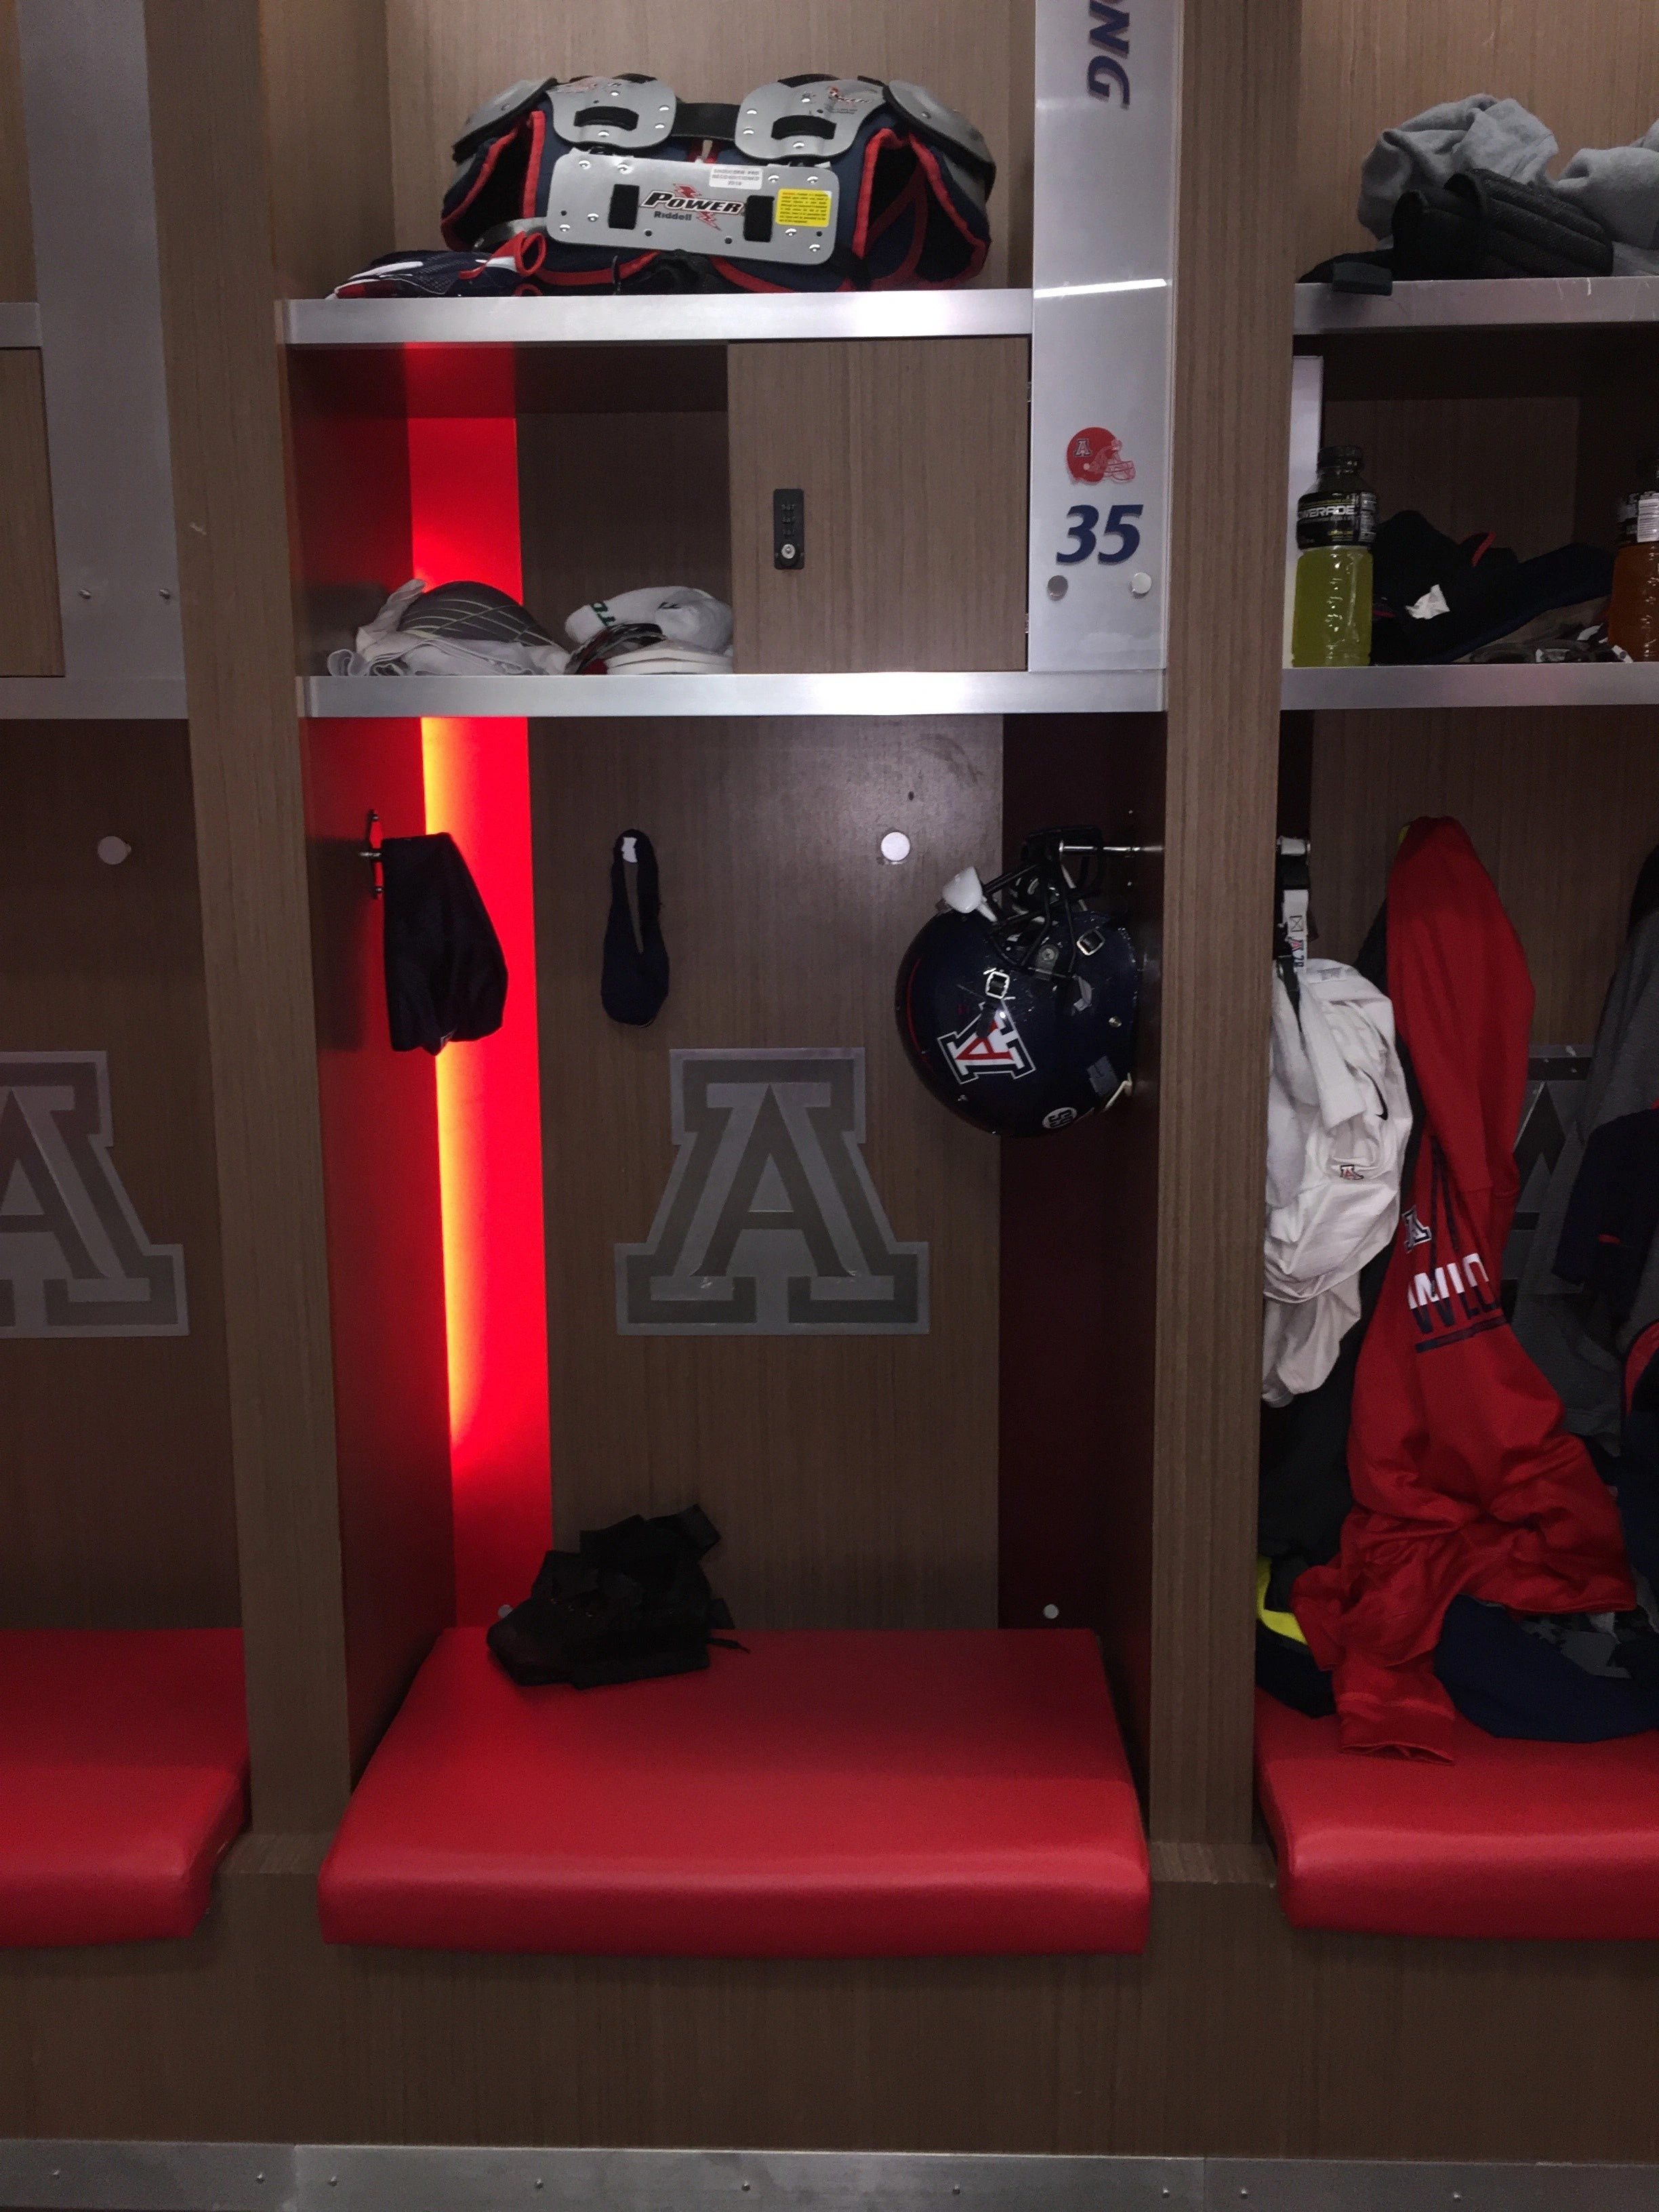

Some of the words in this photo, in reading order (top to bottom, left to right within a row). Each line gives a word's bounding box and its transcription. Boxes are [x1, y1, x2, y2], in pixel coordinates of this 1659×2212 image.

[1087, 0, 1130, 110] NG
[641, 190, 744, 214] POWER
[653, 211, 692, 221] Riddell
[1056, 504, 1143, 565] 35
[613, 1047, 930, 1336] A
